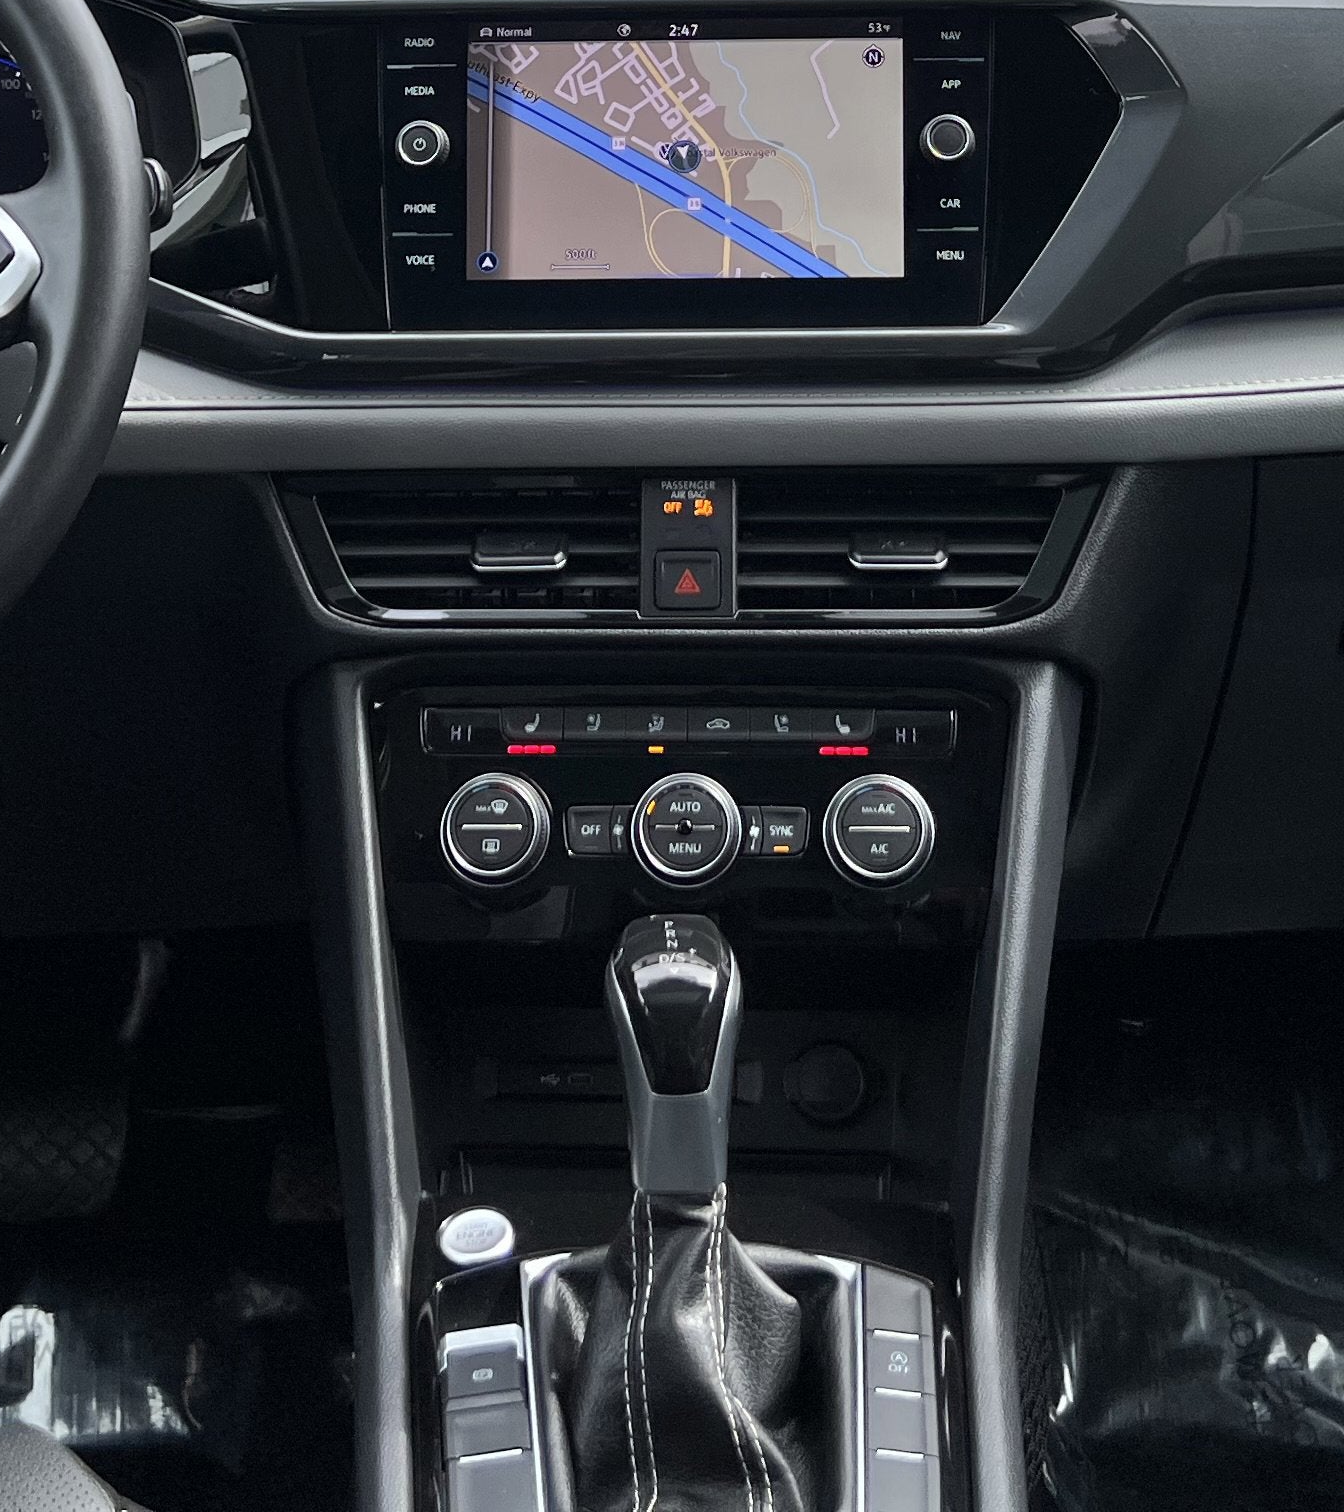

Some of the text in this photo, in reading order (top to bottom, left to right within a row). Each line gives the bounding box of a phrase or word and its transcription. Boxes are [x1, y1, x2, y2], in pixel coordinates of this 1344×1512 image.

[497, 26, 532, 39] Normal
[668, 23, 698, 37] 2:47
[940, 30, 962, 41] NAV
[404, 37, 435, 48] RADIO
[0, 77, 21, 90] 100
[941, 79, 962, 90] APP
[404, 86, 435, 96] MEDIA
[719, 147, 777, 160] Volkswagen
[404, 203, 436, 214] PHONE
[940, 198, 961, 209] CAR
[405, 254, 435, 266] VOICE
[936, 250, 965, 261] MENU
[661, 480, 716, 490] PASSENGER
[669, 801, 701, 813] AUTO
[877, 803, 896, 814] A/C
[581, 823, 601, 836] OFF
[769, 824, 795, 837] SYNC
[669, 842, 702, 854] MENU
[870, 843, 889, 855] A/C
[666, 939, 679, 950] N
[888, 1363, 910, 1374] OFF
